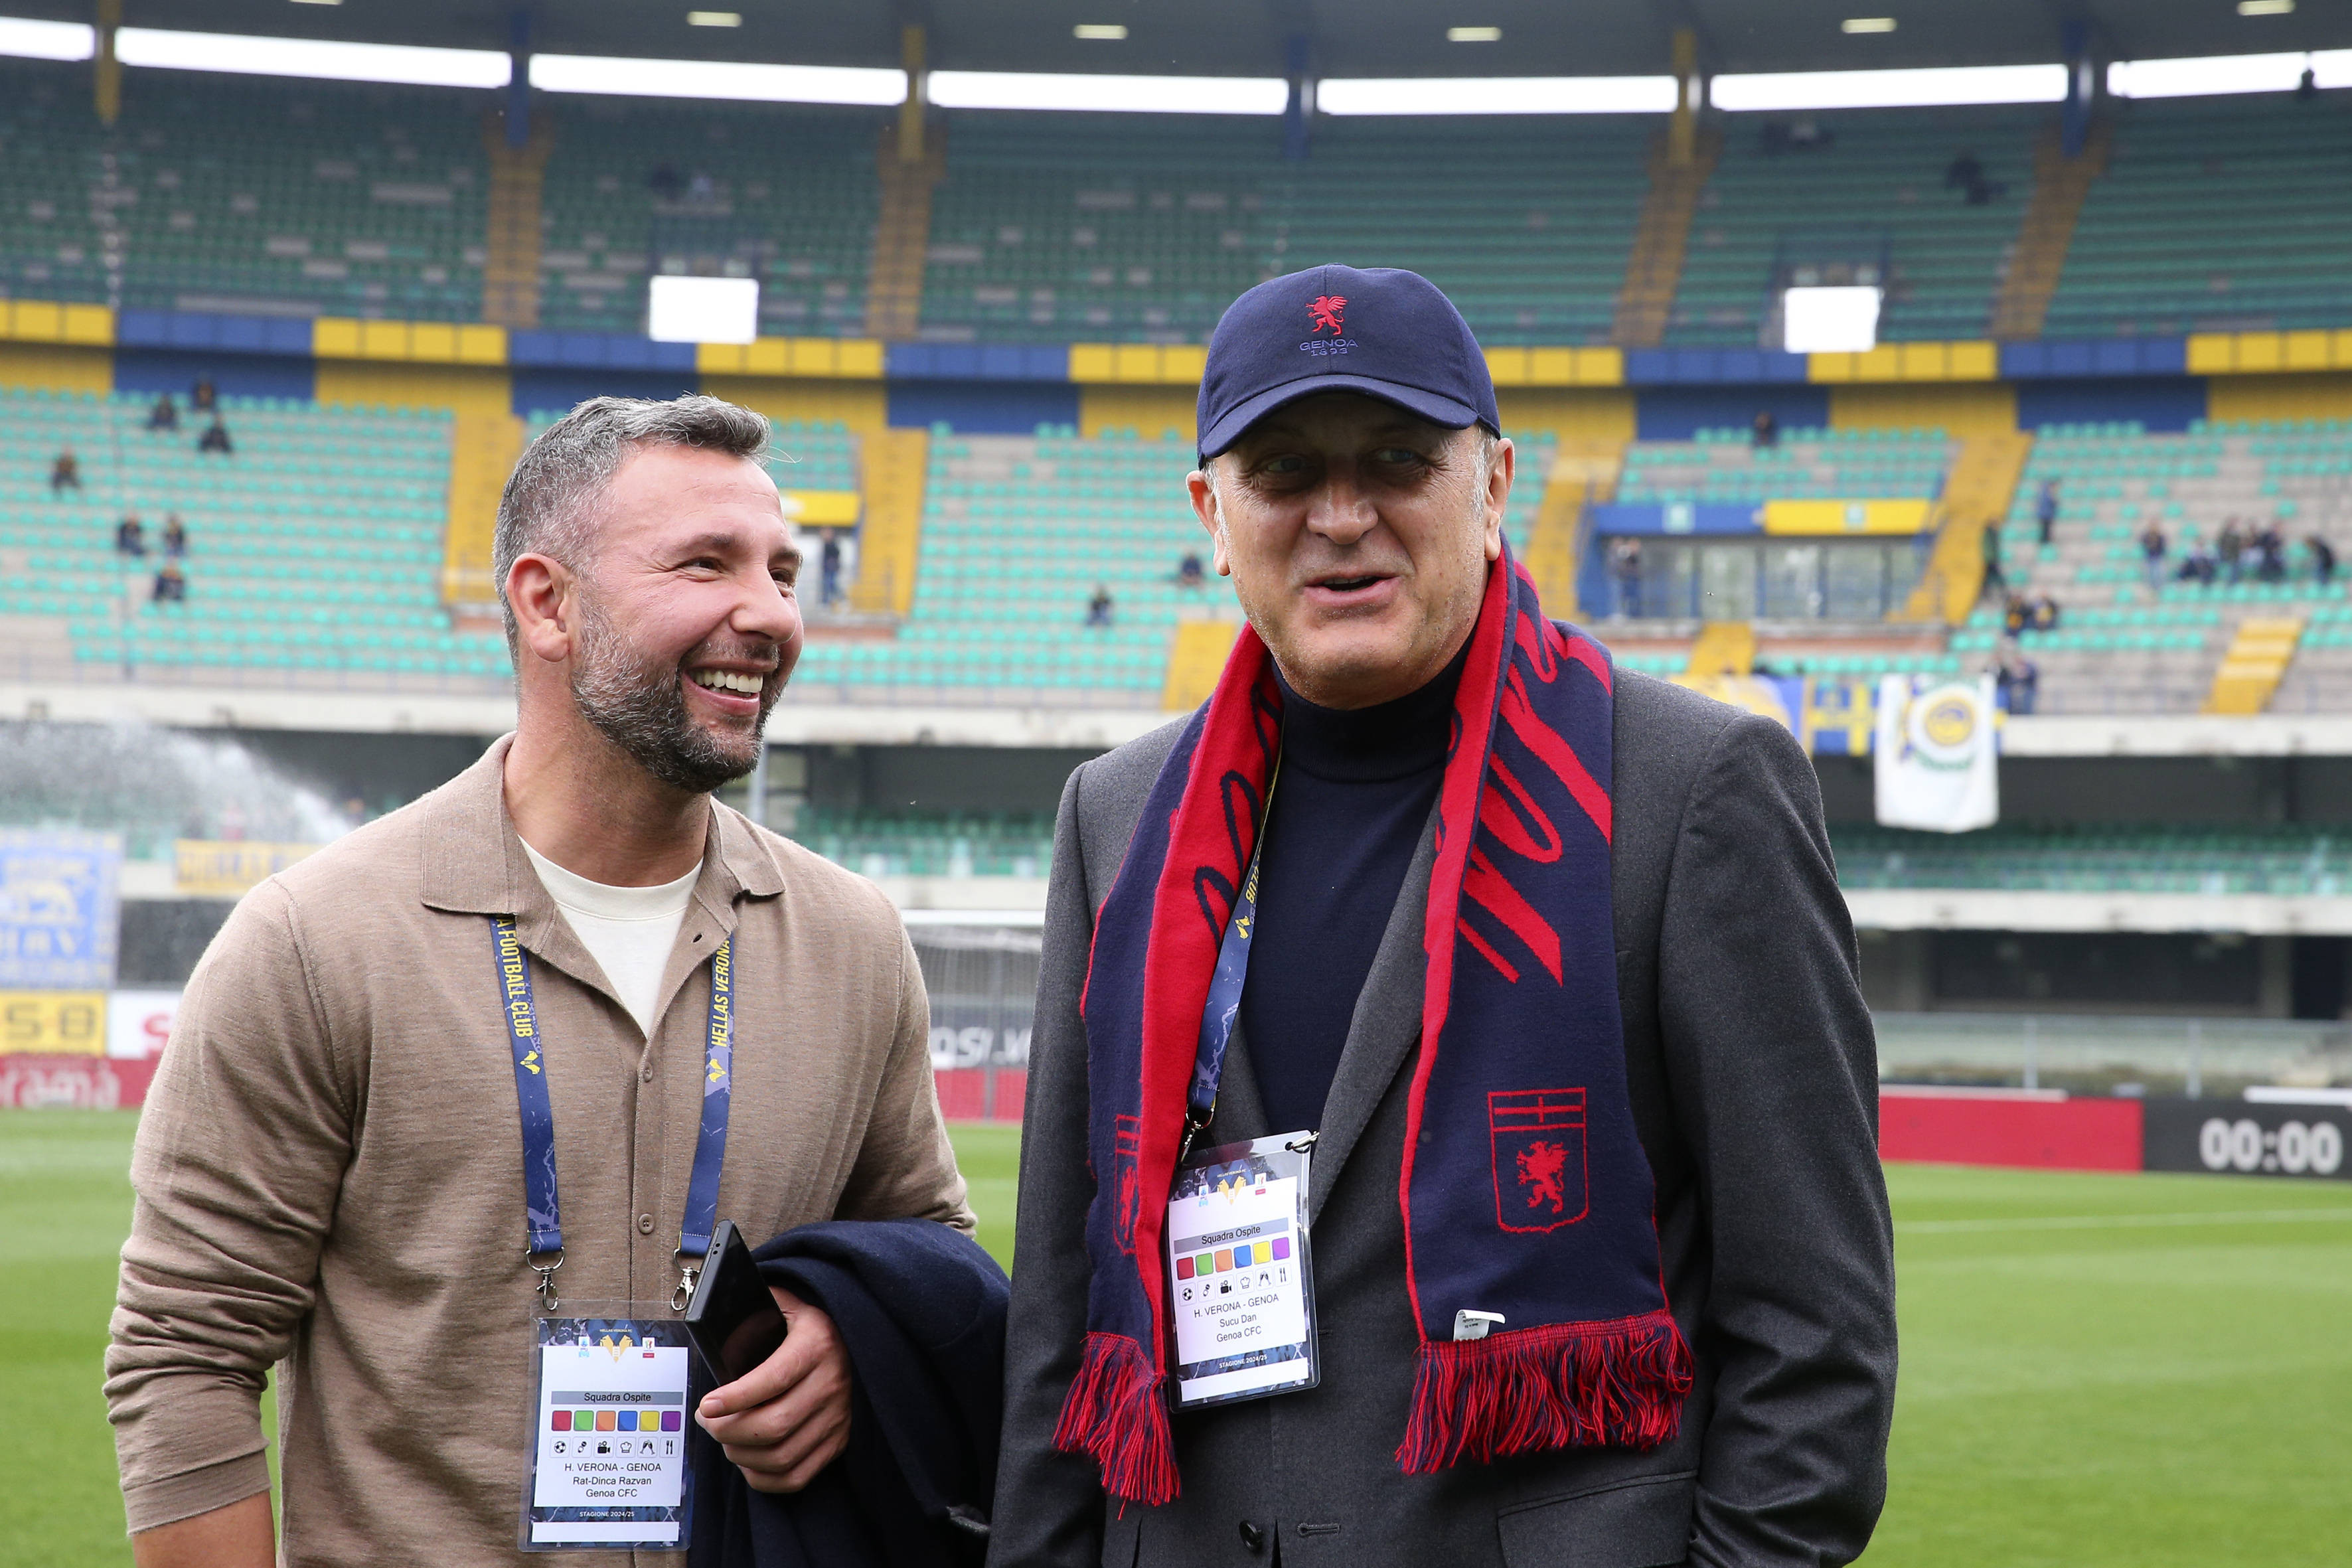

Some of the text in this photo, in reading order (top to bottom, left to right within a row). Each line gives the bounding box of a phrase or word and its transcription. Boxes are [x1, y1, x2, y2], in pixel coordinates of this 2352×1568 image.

[1299, 339, 1358, 351] GENOA
[1310, 347, 1348, 356] 1893
[498, 931, 526, 1000] FOOTBALL
[510, 1001, 534, 1038] CLUB
[711, 994, 729, 1048] HELLAS
[2199, 1117, 2343, 1175] 00:00
[1202, 1226, 1261, 1245] Squadra Ospite
[1194, 1309, 1203, 1318] H.
[1204, 1301, 1241, 1315] VERONA
[1248, 1293, 1279, 1307] GENOA
[1219, 1314, 1257, 1328] Sucu Dan
[1216, 1326, 1262, 1342] Genoa CFC
[1219, 1354, 1267, 1368] STAGIONE 2024/25
[584, 1393, 651, 1403] Squadra Ospite
[573, 1476, 651, 1485] Rat-Dinca Razvan
[586, 1489, 637, 1498] Genoa CFC
